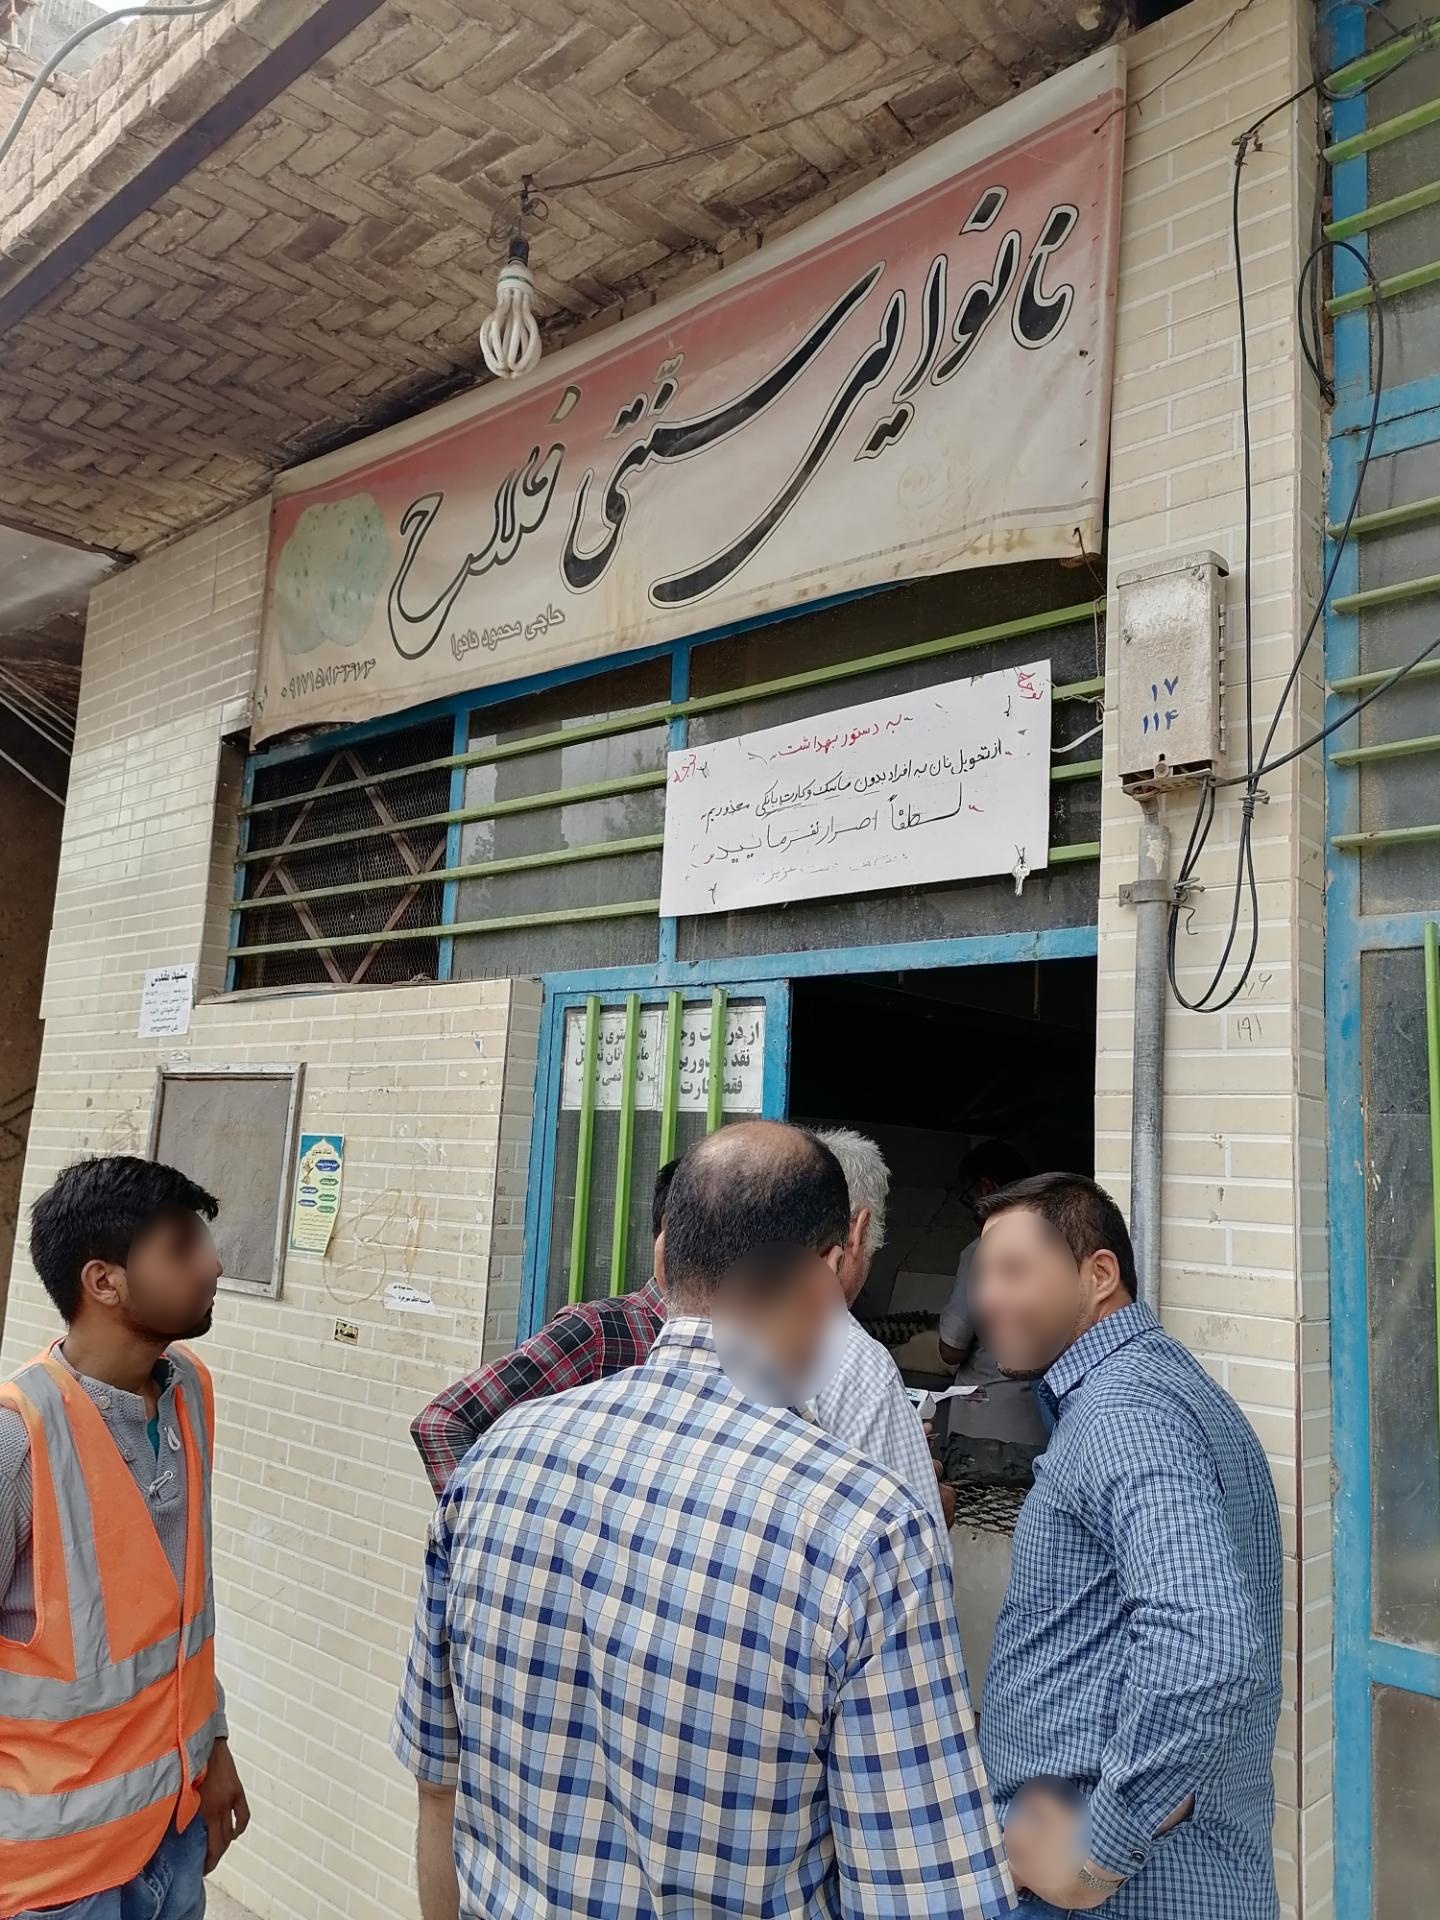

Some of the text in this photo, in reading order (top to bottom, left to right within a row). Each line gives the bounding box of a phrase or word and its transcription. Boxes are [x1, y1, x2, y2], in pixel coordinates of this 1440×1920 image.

[648, 185, 1079, 609] نانوایی
[388, 384, 581, 660] فلاح
[451, 603, 565, 661] حاجی محمود نانوا
[1151, 676, 1179, 702] ۱۷
[1143, 708, 1179, 735] ۱۱۴
[778, 733, 838, 757] بهداشت
[841, 724, 879, 747] دستور
[812, 770, 851, 797] ماسک
[854, 771, 887, 793] بدون
[815, 810, 878, 846] اصرار
[747, 1021, 759, 1045] از
[731, 1049, 750, 1067] نقد
